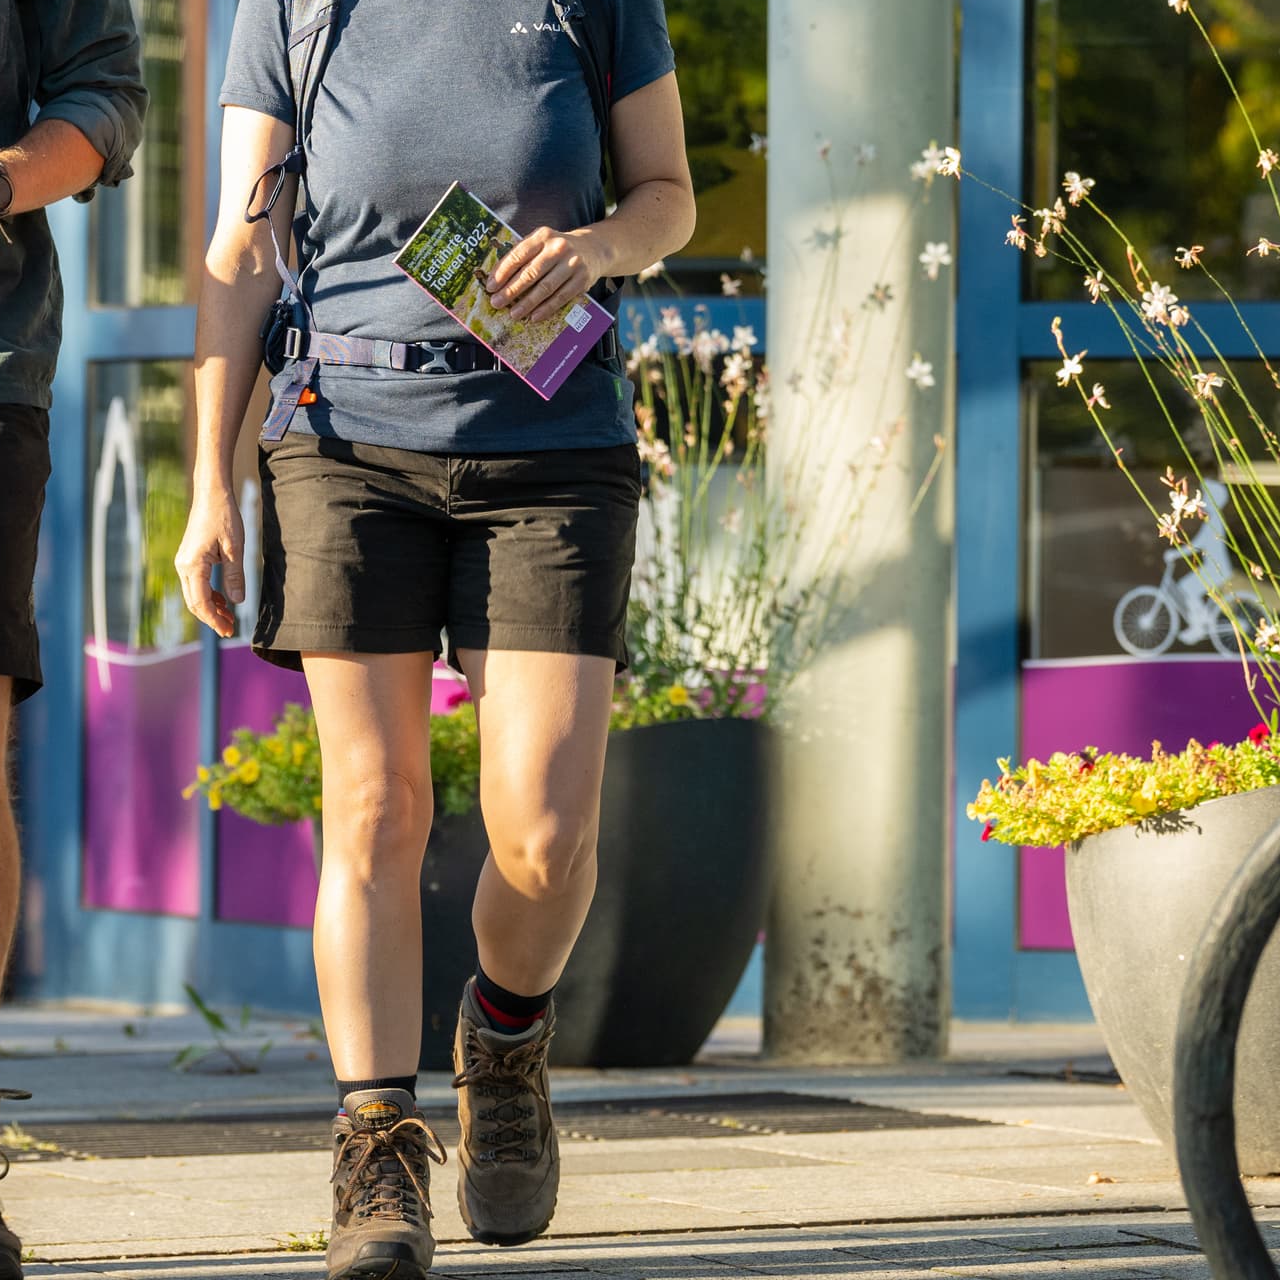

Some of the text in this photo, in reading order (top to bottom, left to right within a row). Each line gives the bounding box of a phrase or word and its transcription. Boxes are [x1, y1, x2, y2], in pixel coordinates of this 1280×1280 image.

[533, 22, 563, 32] VAU
[421, 233, 463, 282] Geführte
[430, 253, 466, 291] Touren
[461, 222, 490, 254] 2022
